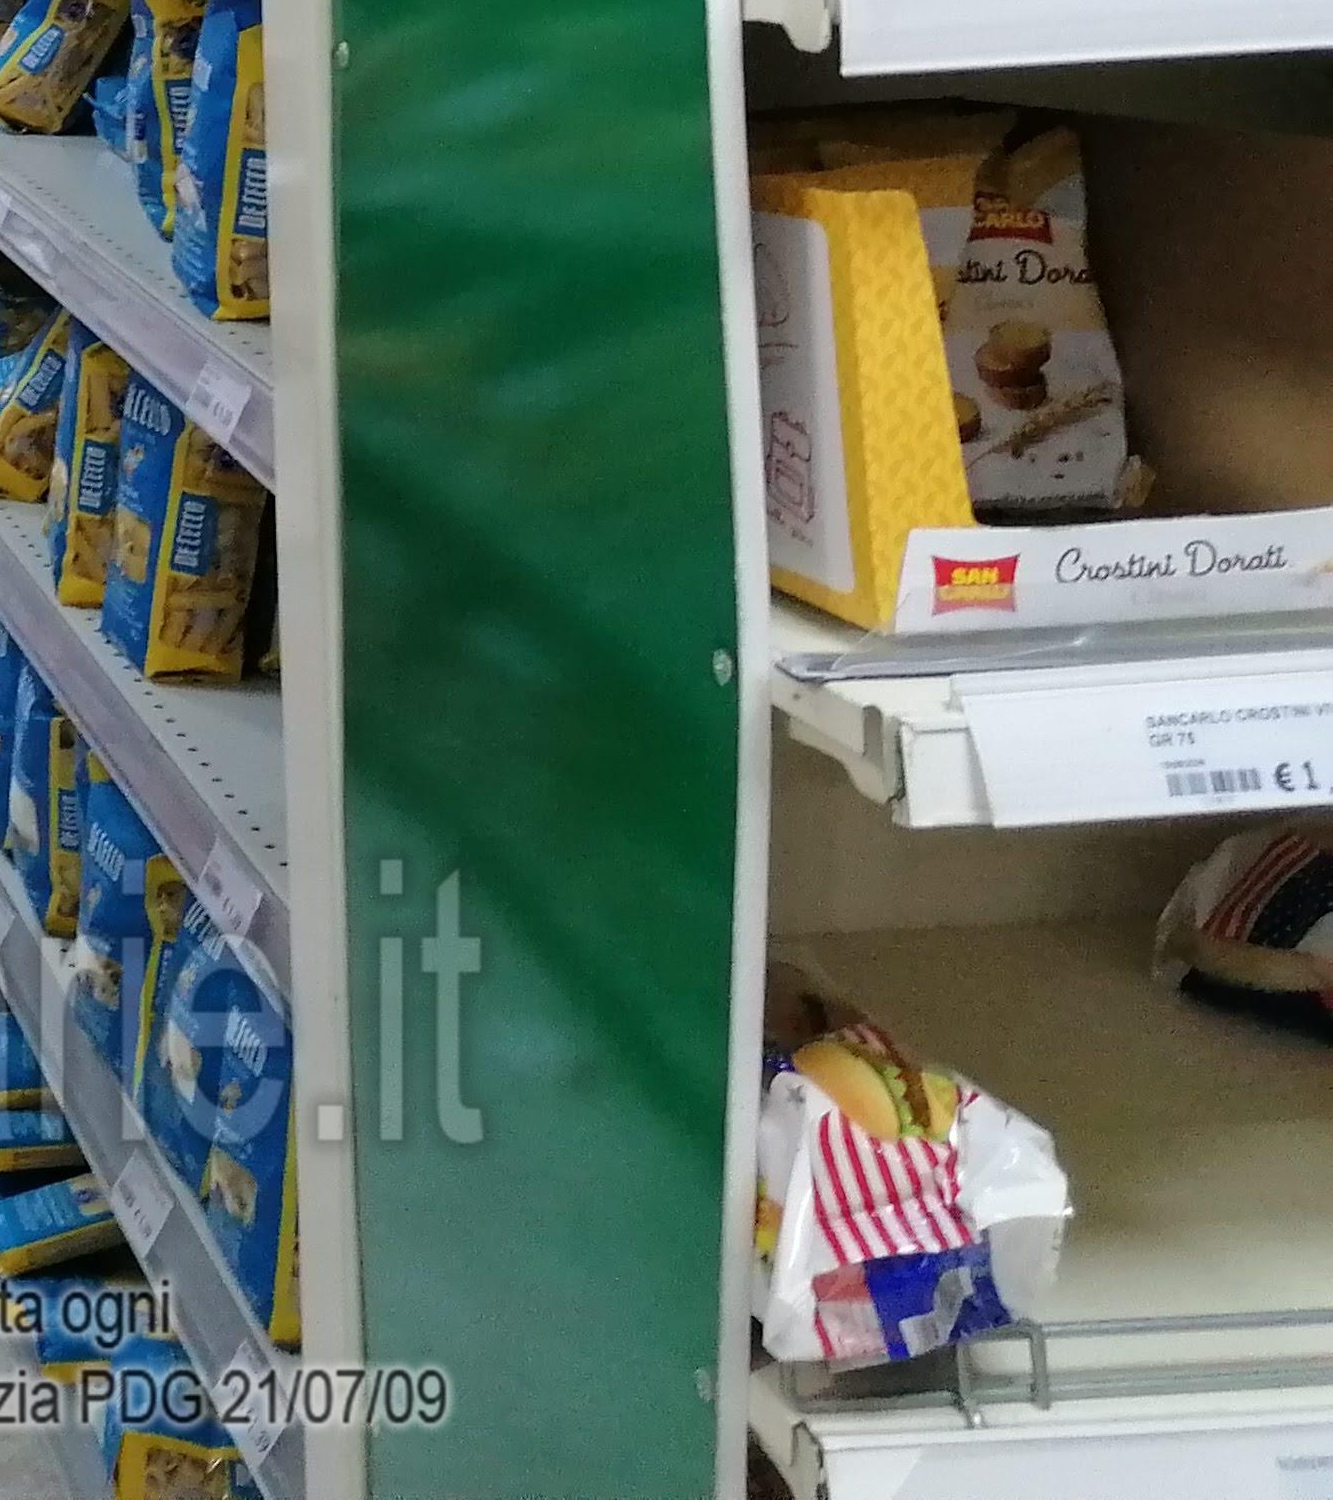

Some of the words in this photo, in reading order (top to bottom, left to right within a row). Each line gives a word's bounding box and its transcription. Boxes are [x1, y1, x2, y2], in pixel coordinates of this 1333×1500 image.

[1014, 249, 1095, 286] Dora
[952, 567, 999, 584] SAN
[1055, 546, 1176, 585] Crostini
[1188, 541, 1287, 576] Dorati
[1274, 762, 1295, 792] €
